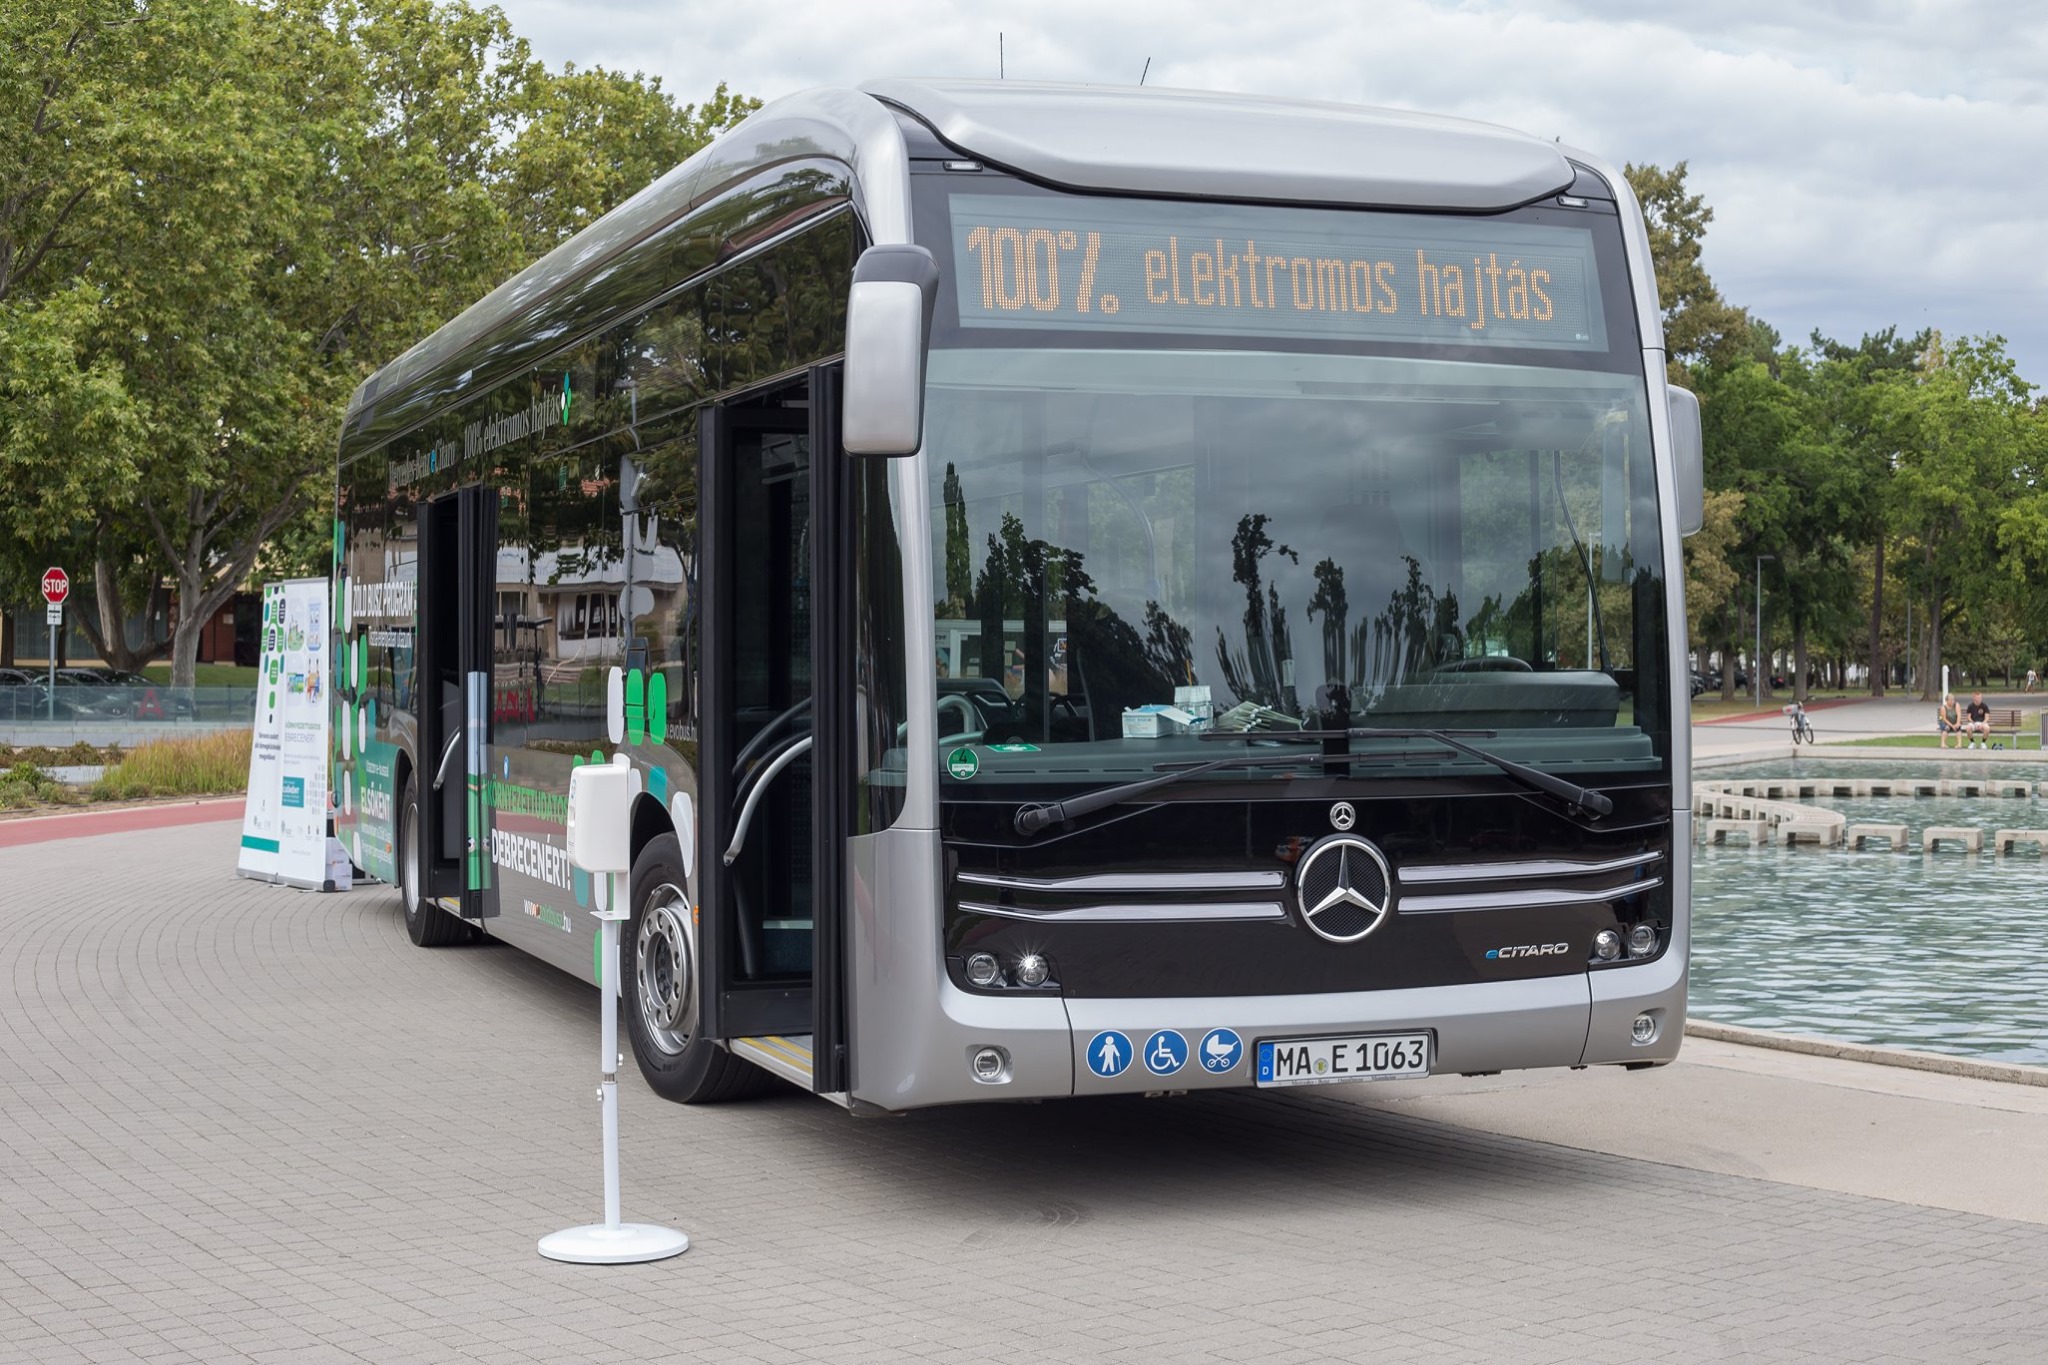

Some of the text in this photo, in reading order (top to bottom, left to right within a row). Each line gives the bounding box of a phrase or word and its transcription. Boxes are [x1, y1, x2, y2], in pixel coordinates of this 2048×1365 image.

[1145, 233, 1397, 315] elektromos
[1416, 248, 1553, 329] hajtás
[464, 419, 482, 460] 100%
[484, 408, 529, 452] elektromos
[532, 385, 560, 439] hajtás
[43, 578, 67, 594] STOP
[353, 575, 413, 617] ZÖLD BUSZ PROGRAM
[959, 749, 968, 764] 4
[491, 828, 571, 891] DEBRECENÉRT!
[1485, 942, 1569, 960] eCITARO
[1262, 1066, 1270, 1076] D
[1276, 1040, 1424, 1077] MA E 1063
